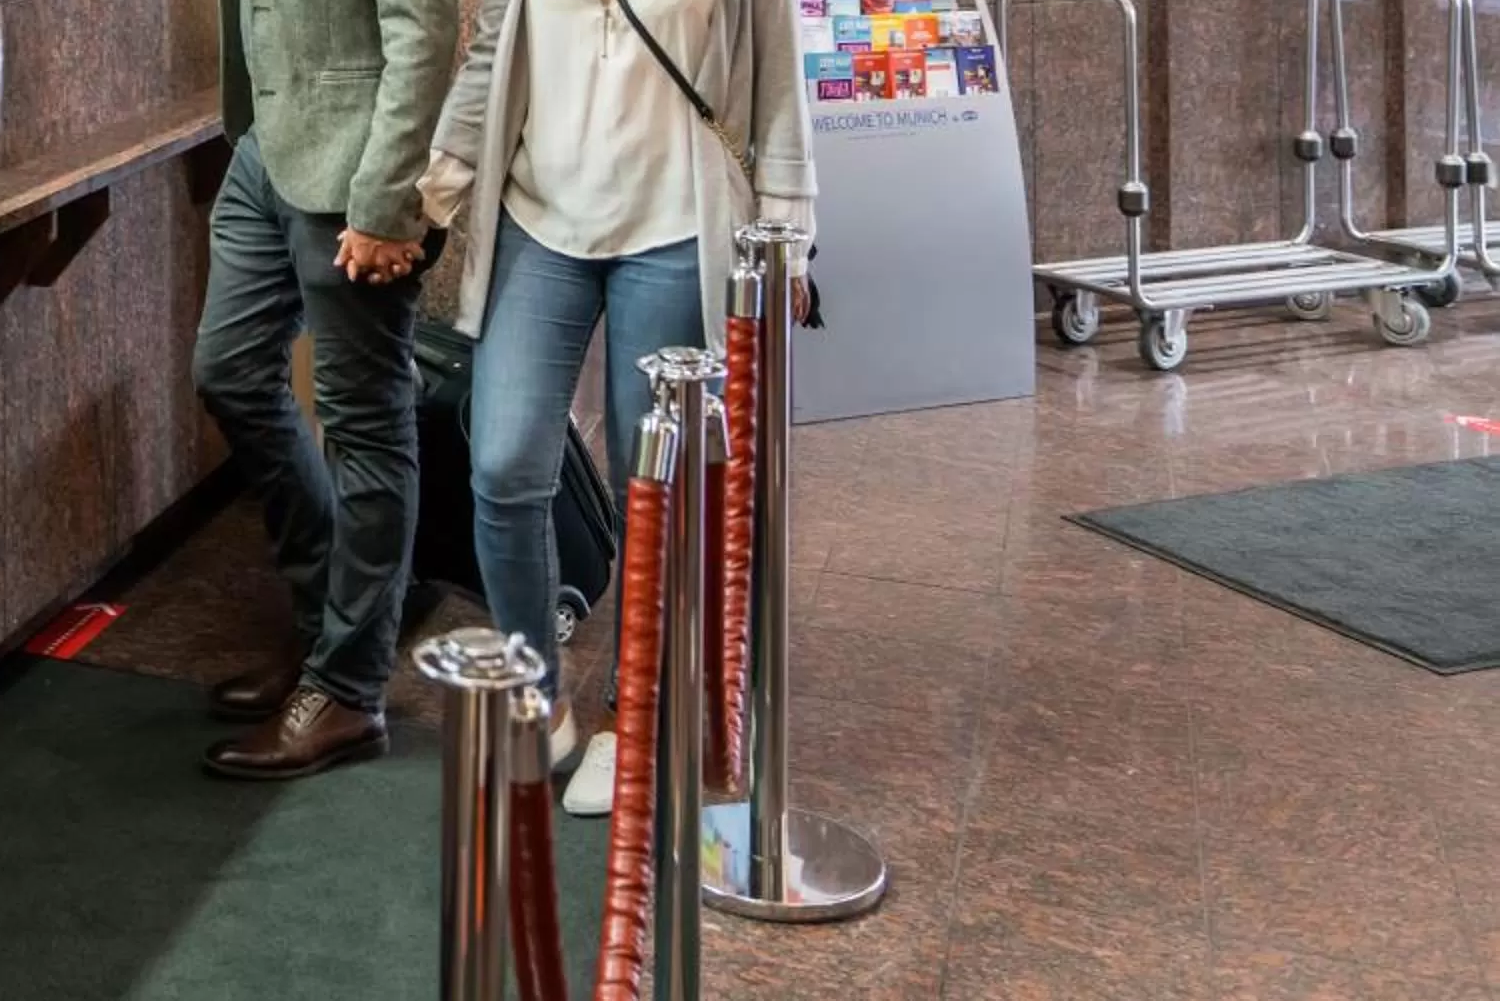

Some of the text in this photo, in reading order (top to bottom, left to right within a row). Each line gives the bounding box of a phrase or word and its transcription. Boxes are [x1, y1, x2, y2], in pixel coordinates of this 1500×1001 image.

[811, 114, 875, 133] WELCOME
[877, 112, 891, 129] TO
[896, 109, 948, 128] MUNICH
